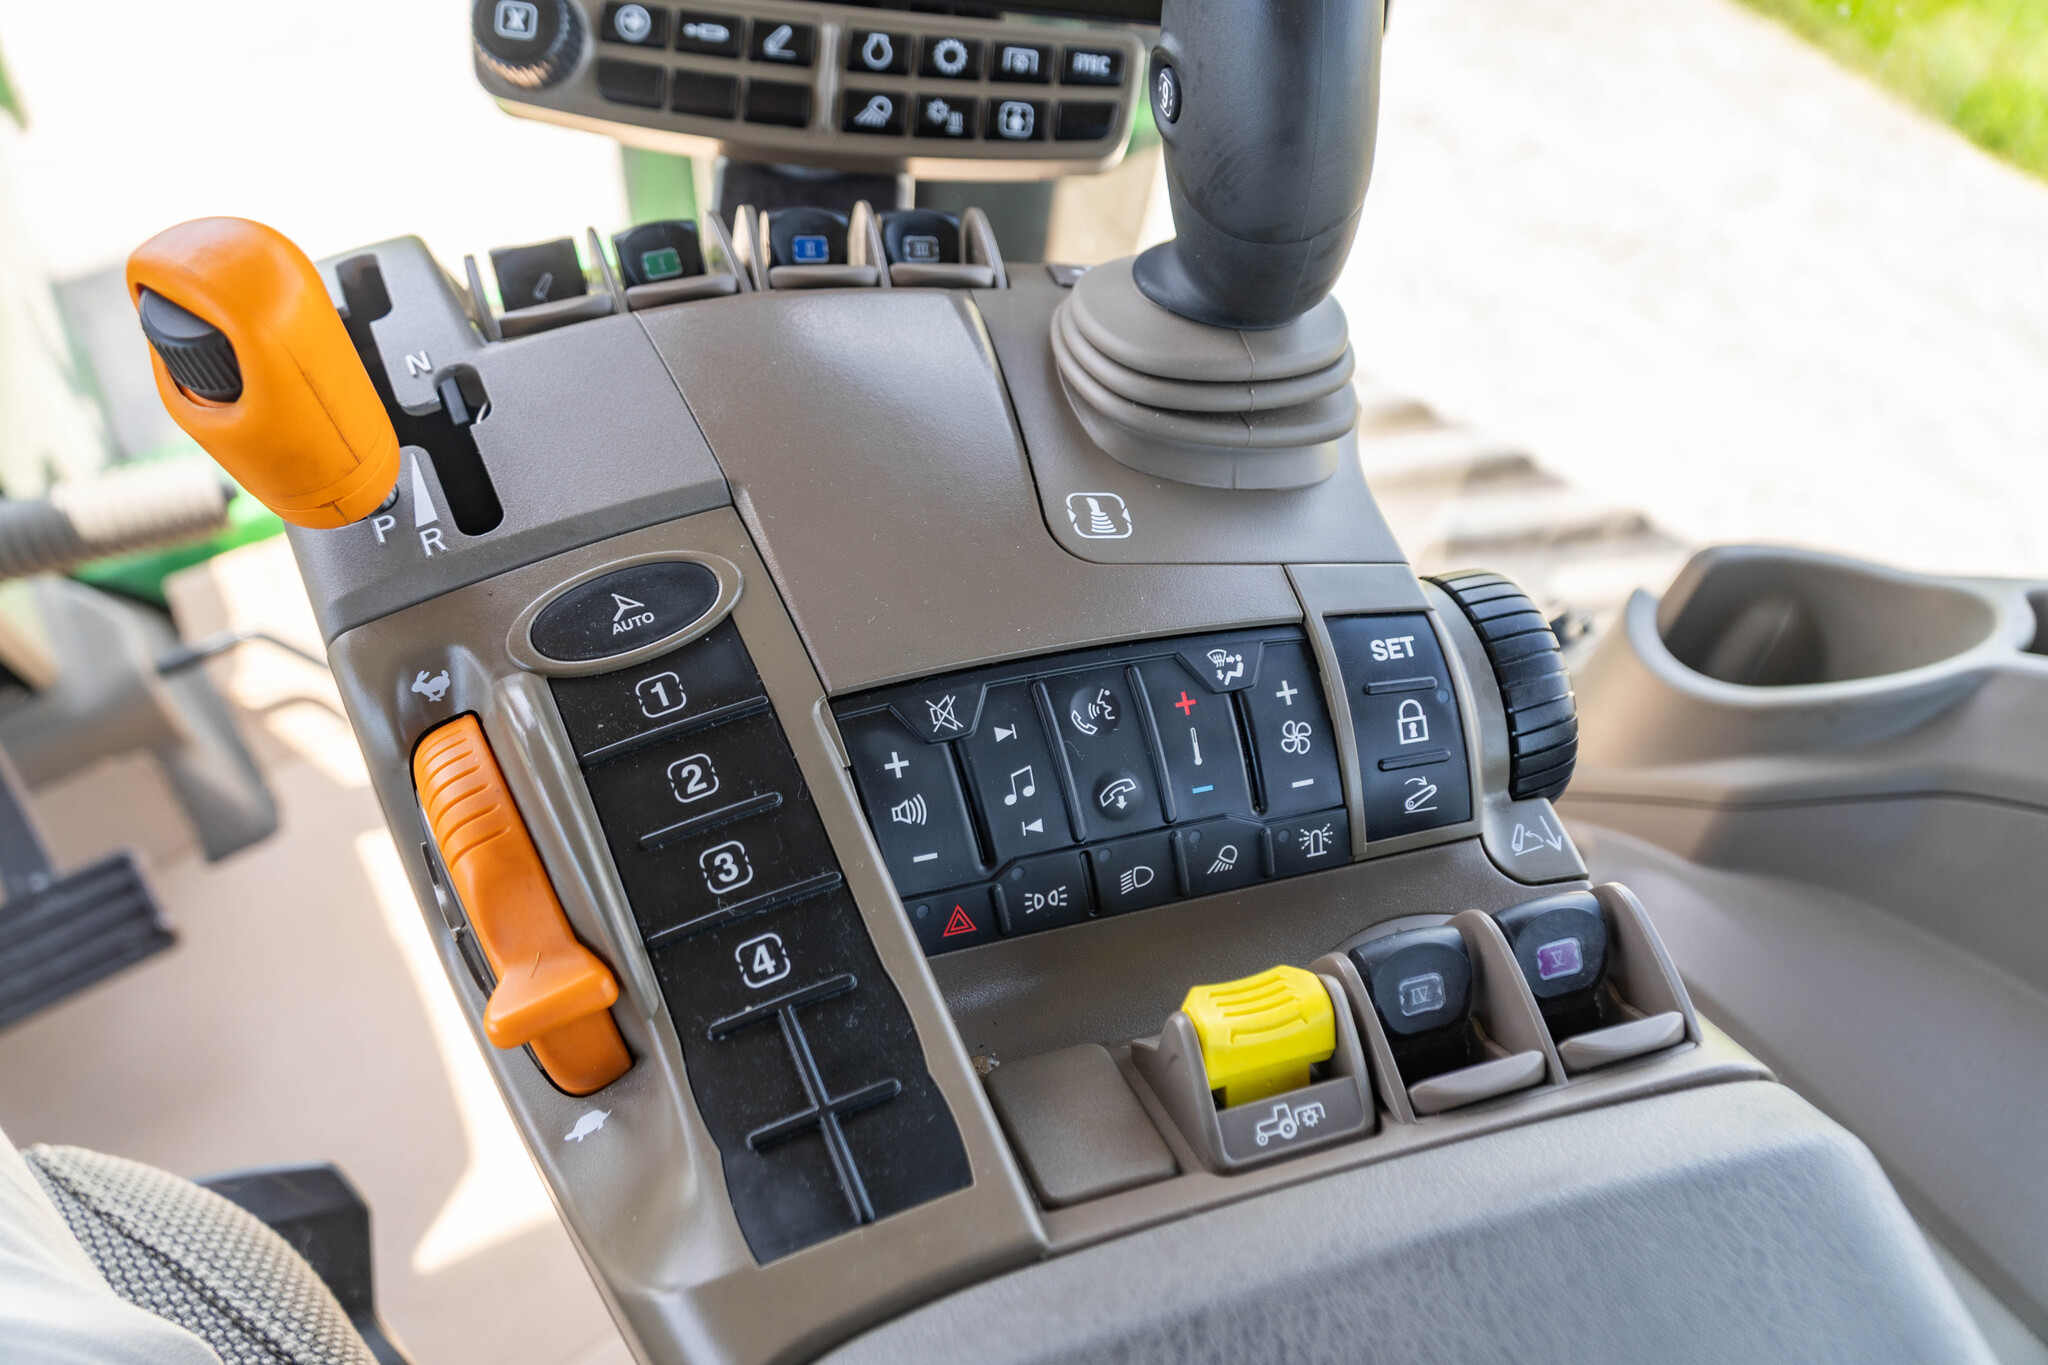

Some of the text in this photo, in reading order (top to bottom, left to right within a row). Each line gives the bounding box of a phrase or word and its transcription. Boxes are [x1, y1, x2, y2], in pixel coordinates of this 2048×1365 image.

[405, 351, 432, 377] N
[372, 514, 396, 544] P
[419, 527, 448, 558] R
[611, 611, 655, 635] AUTO
[1370, 635, 1416, 662] SET
[650, 681, 670, 707] 1
[681, 764, 708, 794] 2
[713, 852, 739, 883] 3
[752, 943, 777, 976] 4
[1550, 951, 1565, 968] V
[1410, 984, 1429, 1005] IV
